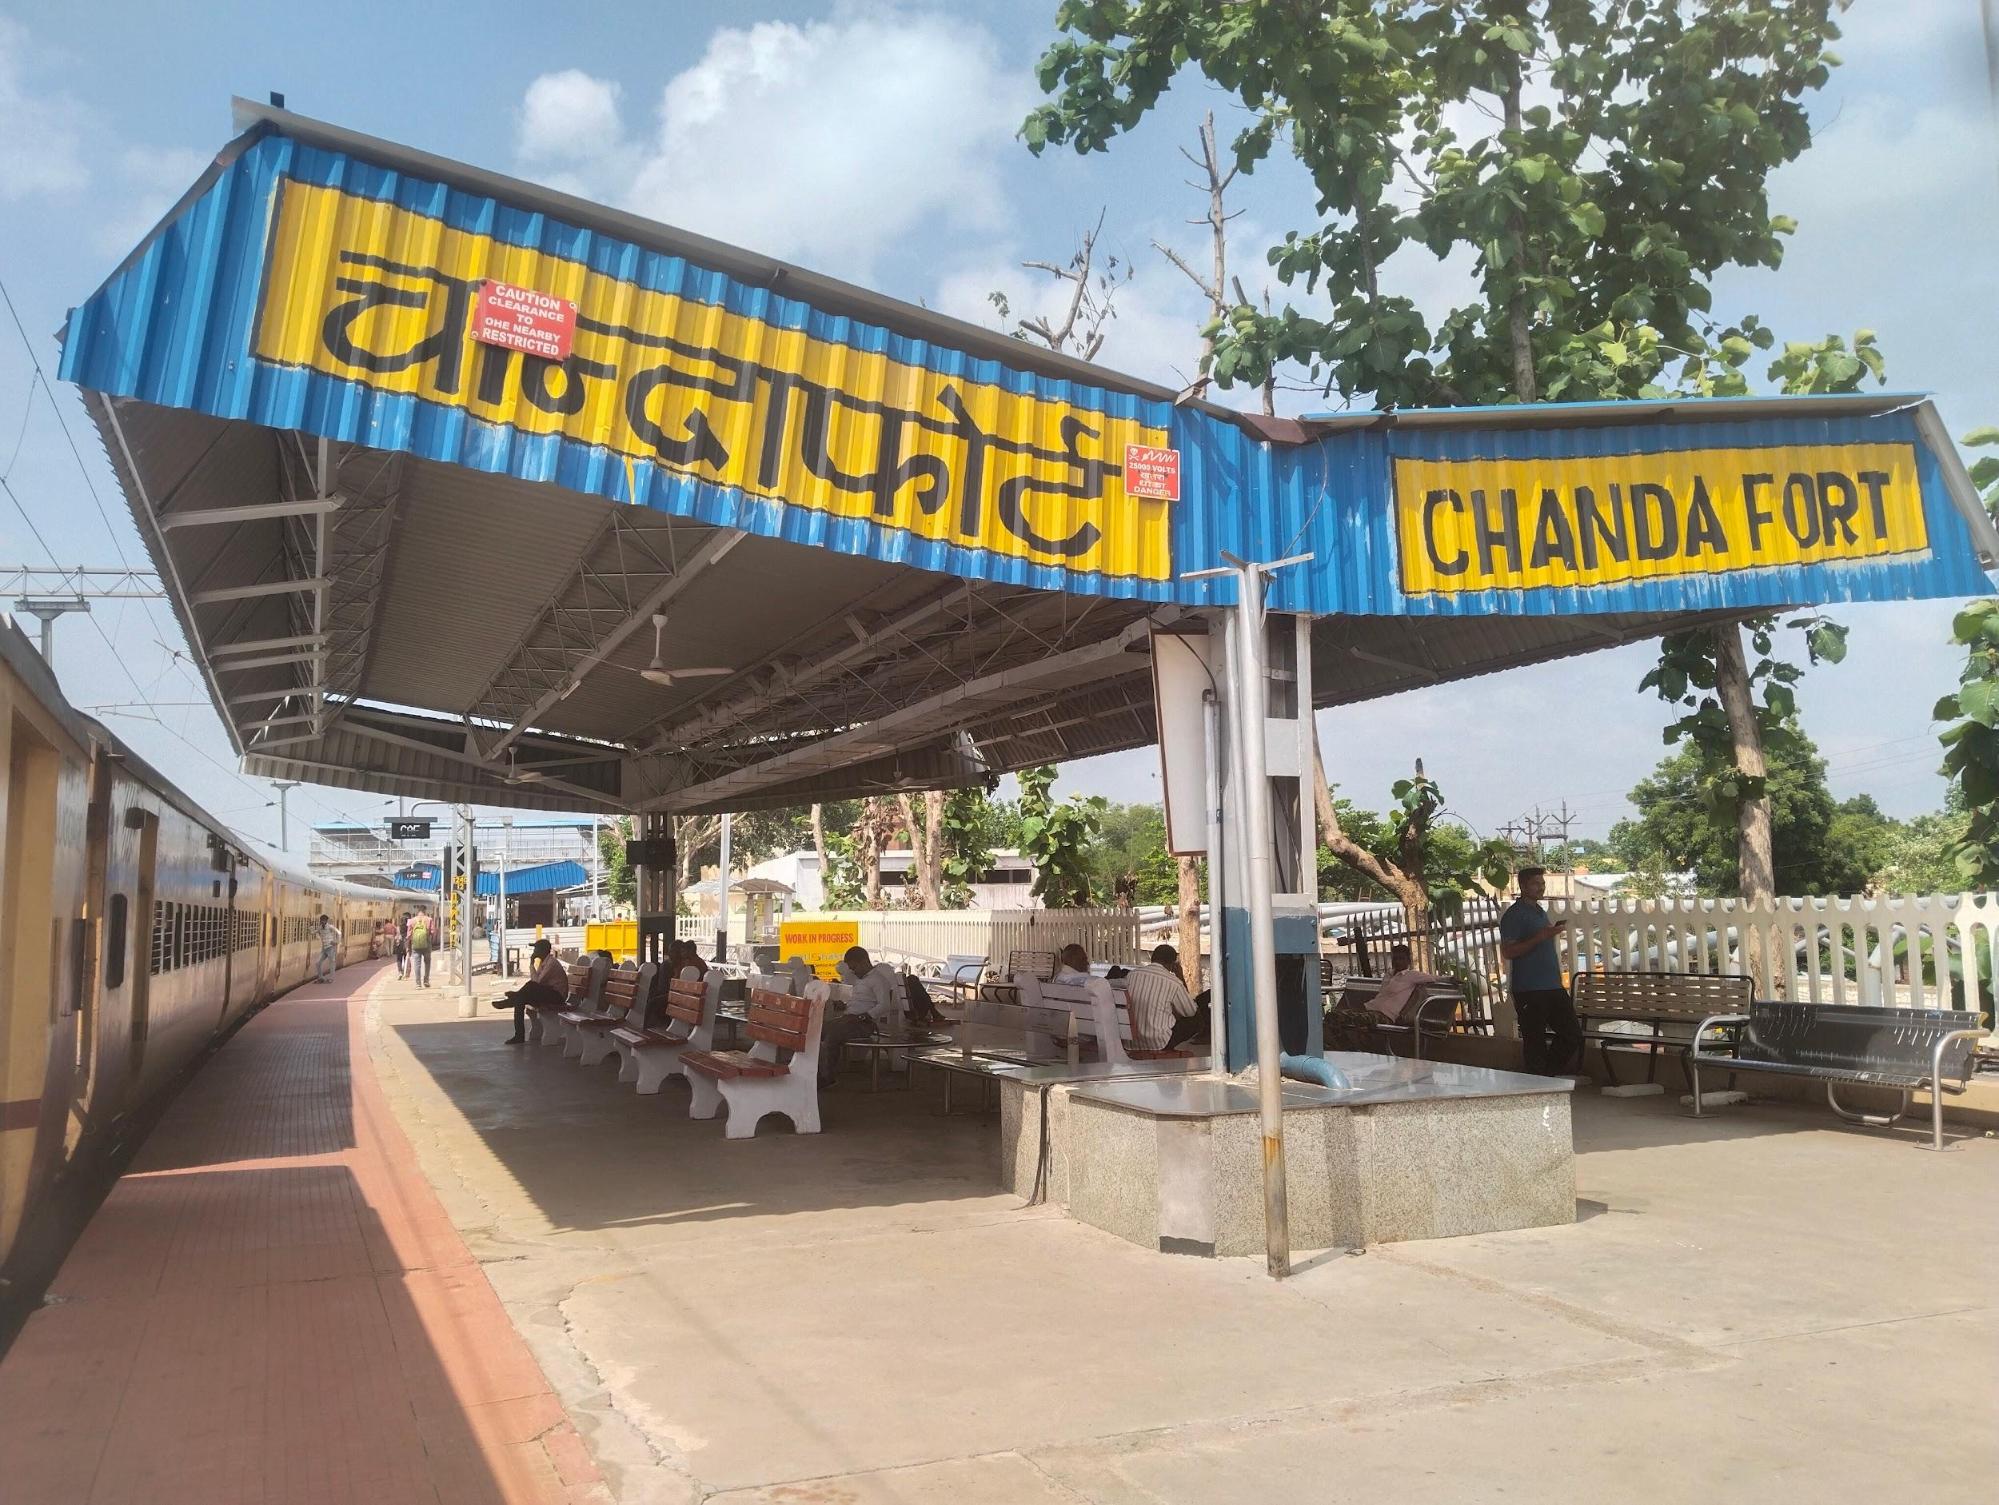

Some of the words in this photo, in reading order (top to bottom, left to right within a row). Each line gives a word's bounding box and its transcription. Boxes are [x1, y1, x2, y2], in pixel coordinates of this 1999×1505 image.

[488, 296, 565, 323] CLEARANCE
[495, 285, 561, 311] CAUTION
[485, 317, 511, 331] OHE
[512, 324, 561, 343] NEARBY
[516, 314, 534, 325] TO
[482, 328, 560, 356] RESTRICTED
[1129, 462, 1151, 471] 25000
[1151, 465, 1176, 474] VOLTS
[1133, 486, 1171, 496] DANGER
[1422, 474, 1730, 577] CHANDA
[1742, 470, 1891, 552] FORT
[785, 933, 808, 944] WORK
[809, 933, 817, 944] IN
[818, 933, 854, 944] PROGRESS
